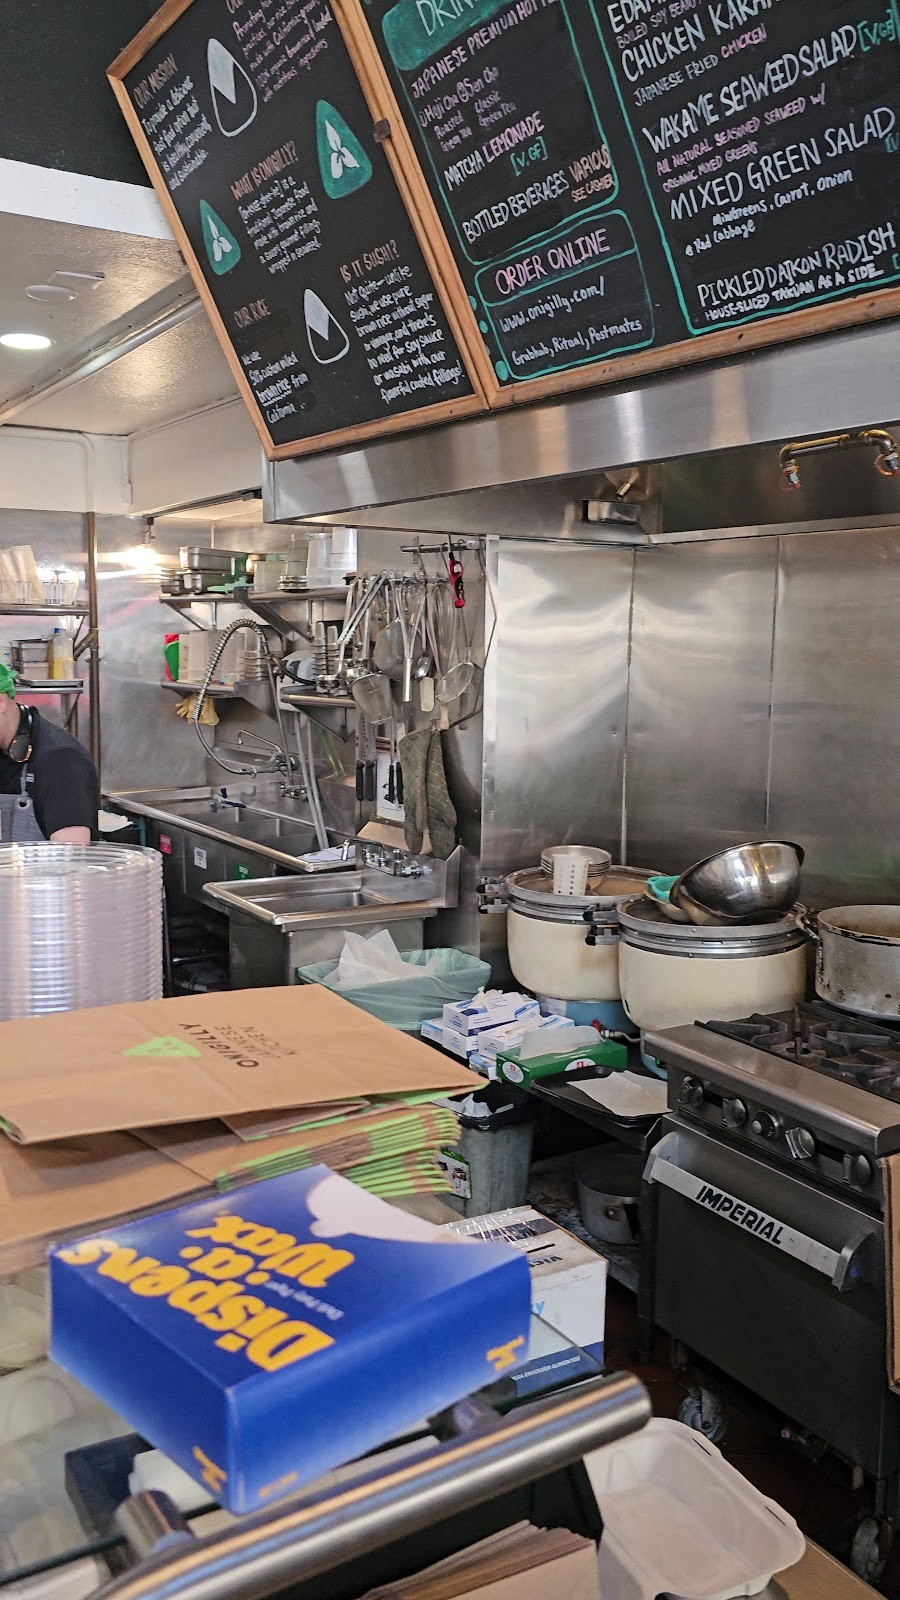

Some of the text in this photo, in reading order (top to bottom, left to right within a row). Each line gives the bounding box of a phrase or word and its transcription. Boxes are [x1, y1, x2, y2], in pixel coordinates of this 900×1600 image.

[411, 46, 467, 99] JAPANESE
[466, 10, 519, 56] PREMIUM
[615, 22, 648, 49] BOILED
[649, 7, 669, 28] SOY
[621, 13, 706, 82] CHICKEN
[134, 53, 178, 109] OUR MISSION
[632, 22, 768, 107] JAPANESE FRIED CHICKEN
[641, 24, 857, 154] WAKAME SEAWEED SALAD
[433, 110, 464, 140] Roasted
[443, 110, 545, 191] MATCHA LEMONADE
[656, 82, 826, 176] ALL NATURAL SEASONED SEAWEED w/
[230, 172, 254, 200] WHAT
[250, 166, 261, 187] IS
[670, 171, 744, 220] MIXED
[746, 137, 822, 193] GREEN
[824, 106, 896, 158] SALAD
[697, 155, 723, 176] MIXED
[724, 141, 759, 163] GREENS
[461, 169, 570, 244] BOTTLED BEVERAGES
[712, 218, 756, 244] Cabbage
[339, 239, 400, 283] IS IT SUSHI?
[495, 227, 610, 295] ORDER ONLINE
[697, 268, 766, 308] PICKLED
[764, 251, 822, 287] DAIKON
[821, 222, 897, 270] RADISH
[233, 306, 254, 328] OUR
[344, 286, 360, 306] Not
[375, 313, 393, 328] rice
[392, 300, 418, 321] without
[392, 285, 413, 304] pure
[704, 293, 770, 322] HOUSE-SLICED
[771, 279, 816, 302] TAKUAN
[817, 273, 833, 290] AS
[834, 271, 846, 287] A
[587, 317, 643, 344] Postmates
[178, 1023, 260, 1068] ONIGILLY
[695, 1185, 784, 1245] IMPERIAL
[54, 1238, 336, 1373] Dispens
